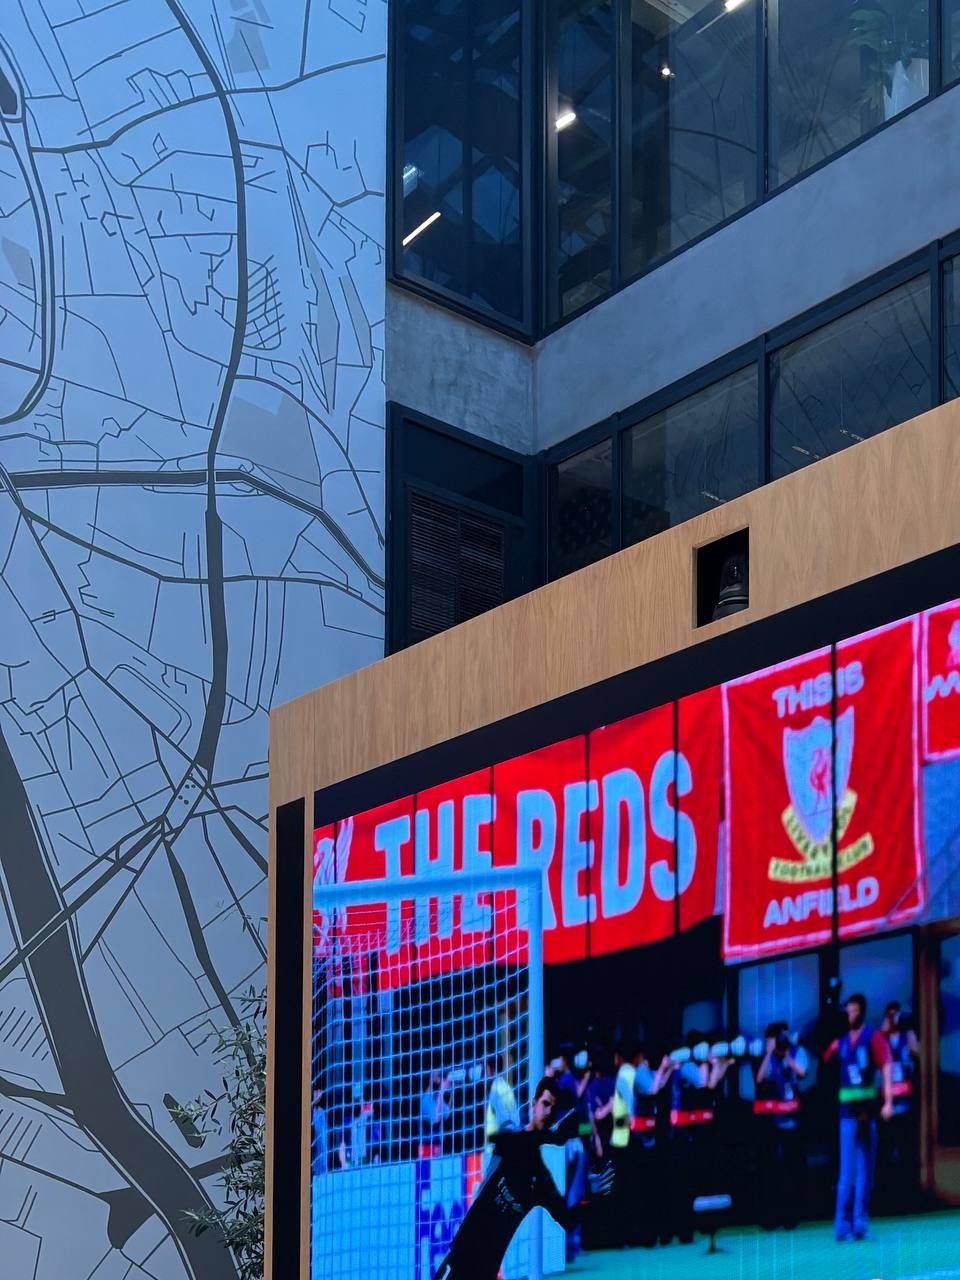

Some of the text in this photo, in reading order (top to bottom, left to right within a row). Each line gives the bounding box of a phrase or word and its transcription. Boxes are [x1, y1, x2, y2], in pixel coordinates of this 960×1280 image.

[772, 660, 865, 719] THIS IS
[375, 794, 496, 955] THE
[516, 750, 697, 931] REDS
[764, 876, 880, 928] ANFIELD
